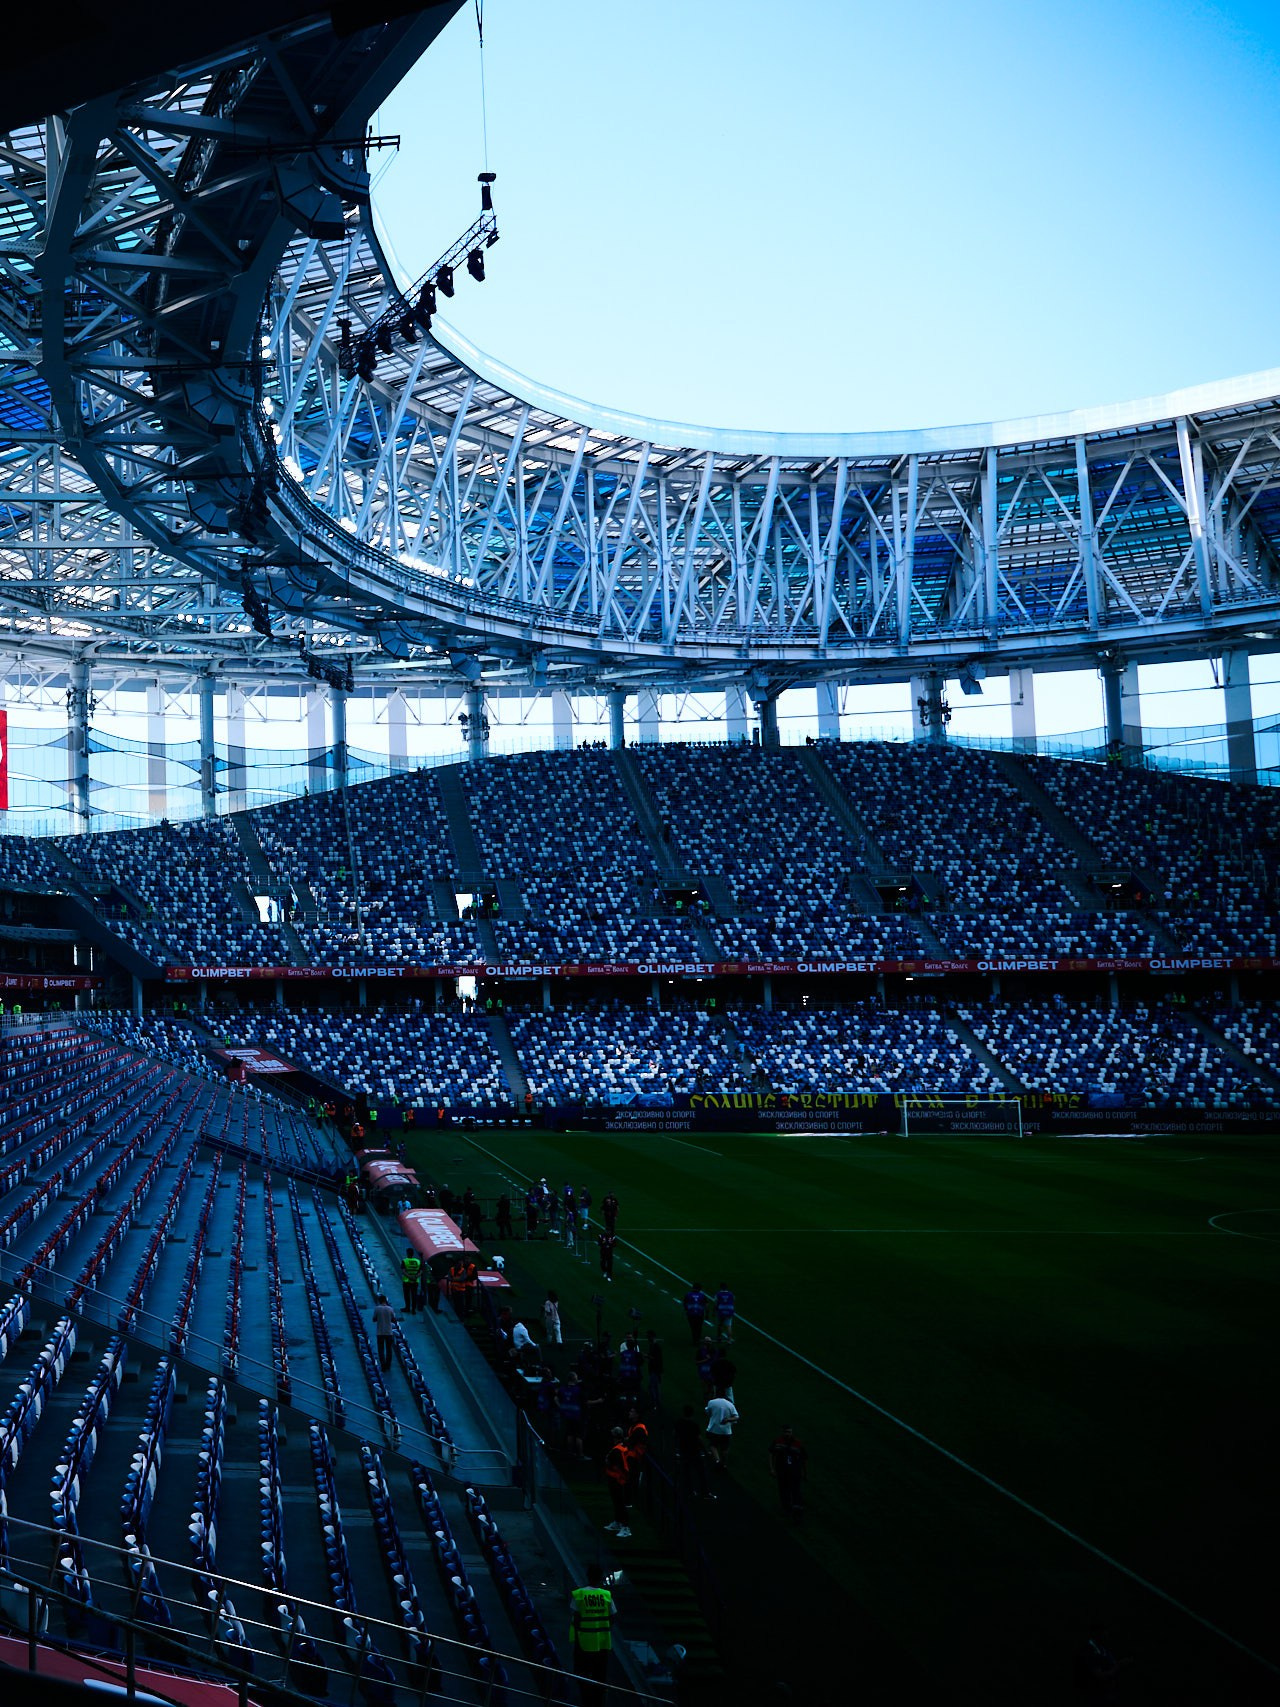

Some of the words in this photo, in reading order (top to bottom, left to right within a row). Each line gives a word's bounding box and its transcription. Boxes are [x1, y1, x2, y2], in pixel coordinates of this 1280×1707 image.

[637, 963, 715, 974] OLIMPBET
[797, 962, 876, 973] OLIMPBET
[977, 960, 1059, 971] OLIMPBET
[1149, 958, 1233, 969] OLIMPBET
[191, 967, 252, 978] OLIMPBET
[331, 967, 406, 977] OLIMPBET
[485, 966, 562, 976] OLIMPBET
[48, 979, 76, 988] OLIMPBET
